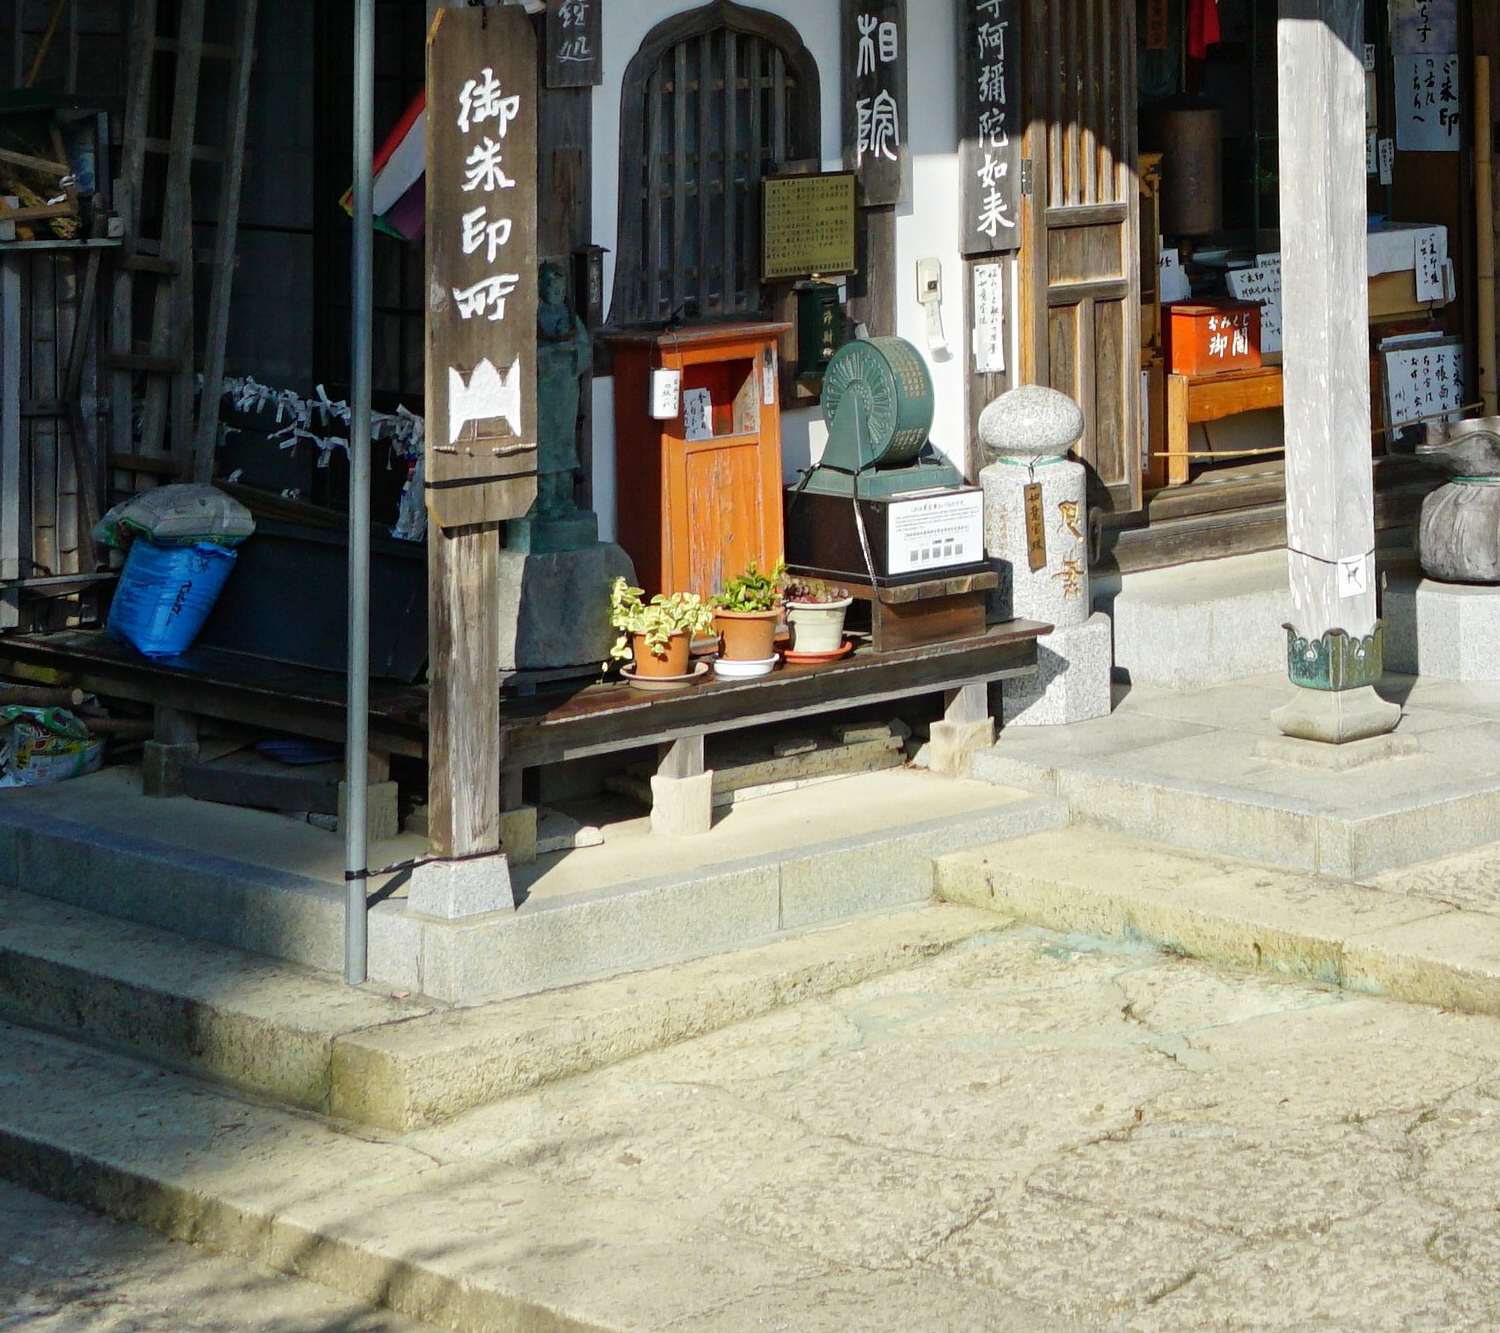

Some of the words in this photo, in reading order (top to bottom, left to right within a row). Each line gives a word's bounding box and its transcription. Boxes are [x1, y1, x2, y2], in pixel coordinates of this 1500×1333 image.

[1439, 59, 1460, 137] ご朱印
[452, 66, 521, 321] 御朱印所
